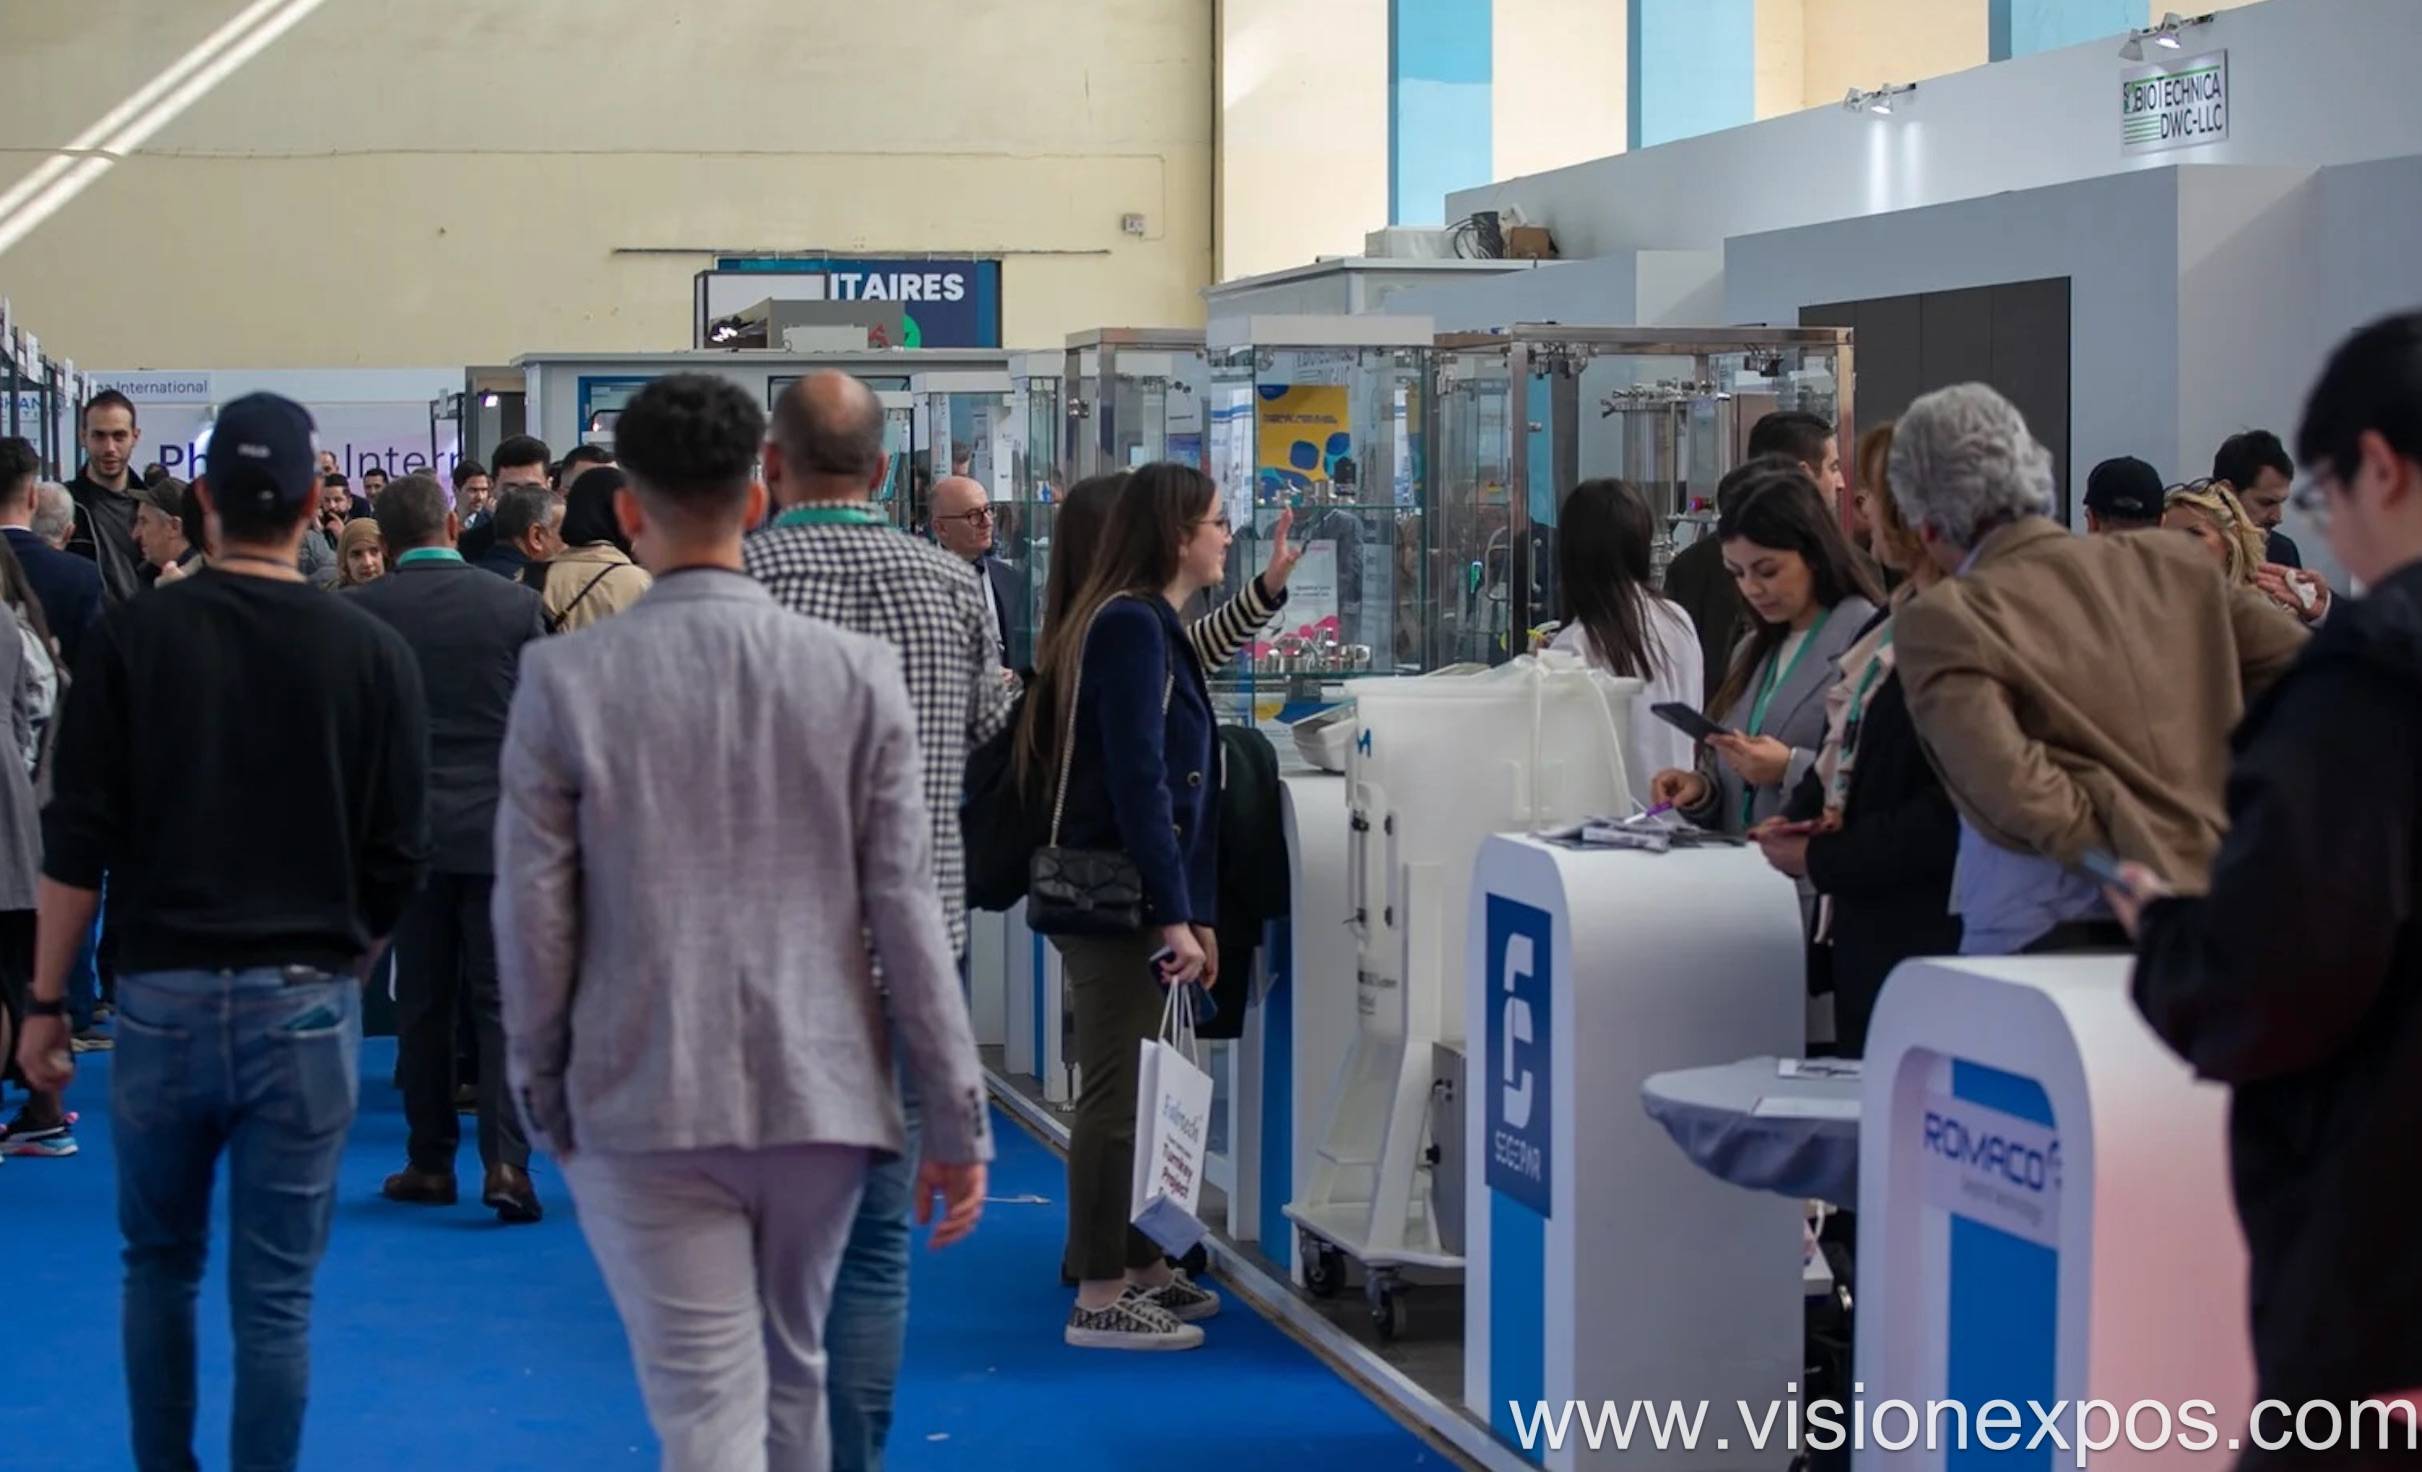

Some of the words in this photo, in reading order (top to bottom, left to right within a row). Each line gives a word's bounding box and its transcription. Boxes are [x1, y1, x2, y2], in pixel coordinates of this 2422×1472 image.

[2134, 72, 2222, 112] BIOTECHNICA
[2161, 103, 2222, 139] DWC-LLC
[830, 272, 965, 301] ITAIRES
[117, 380, 208, 395] International
[1923, 1111, 2046, 1192] ROMACO
